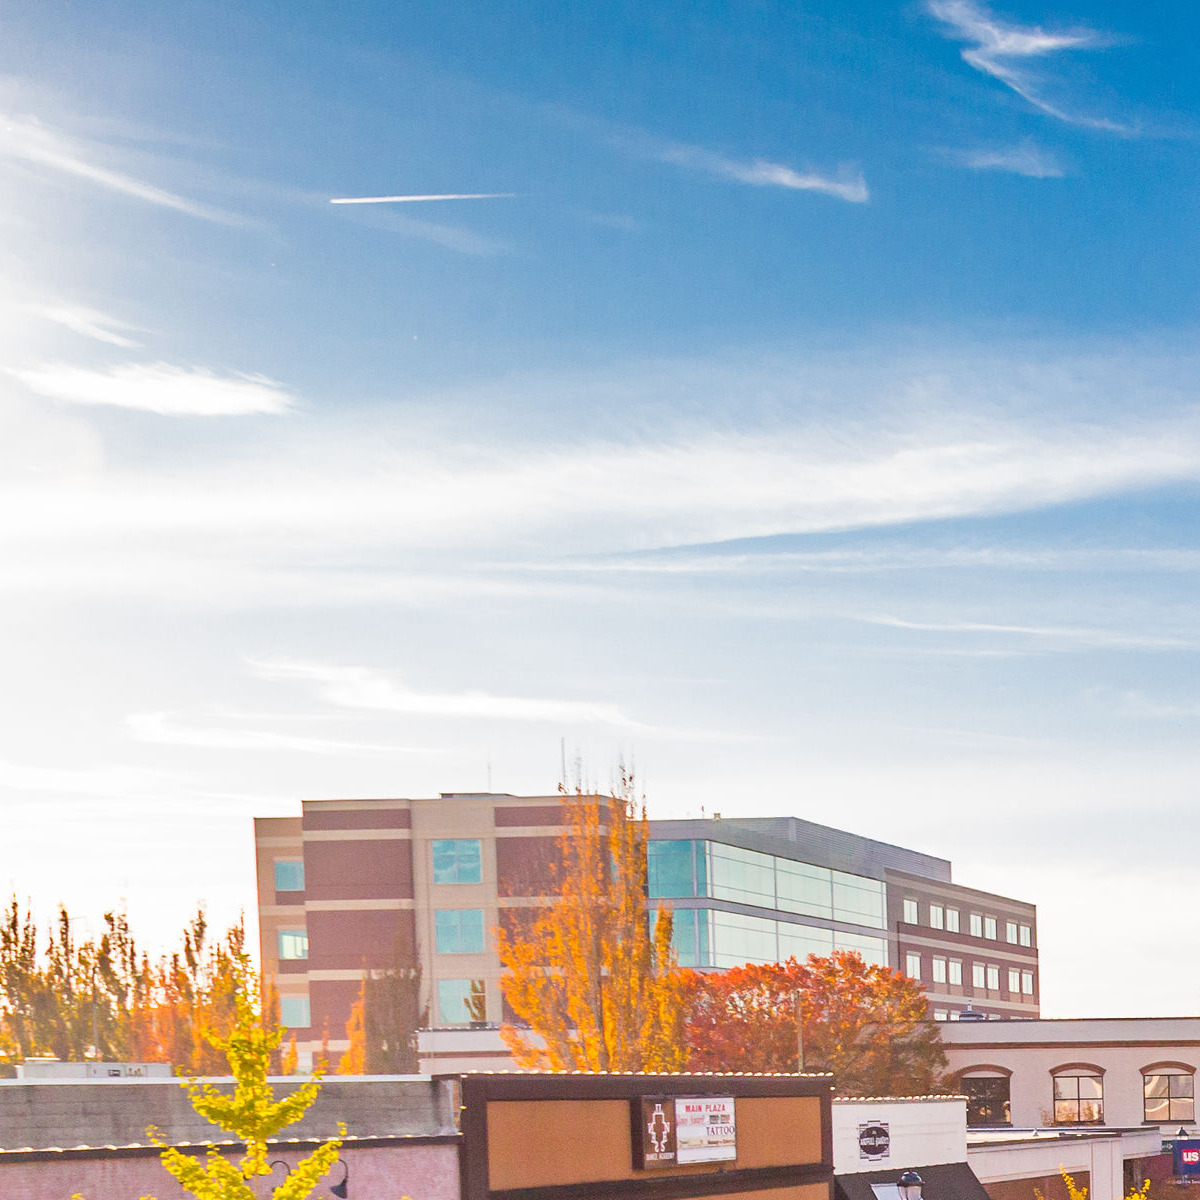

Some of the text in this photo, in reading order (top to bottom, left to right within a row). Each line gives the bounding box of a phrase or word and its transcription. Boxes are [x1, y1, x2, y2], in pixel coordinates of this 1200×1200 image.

[685, 1104, 726, 1113] MAIN PLAZA
[706, 1126, 736, 1136] TATTOO
